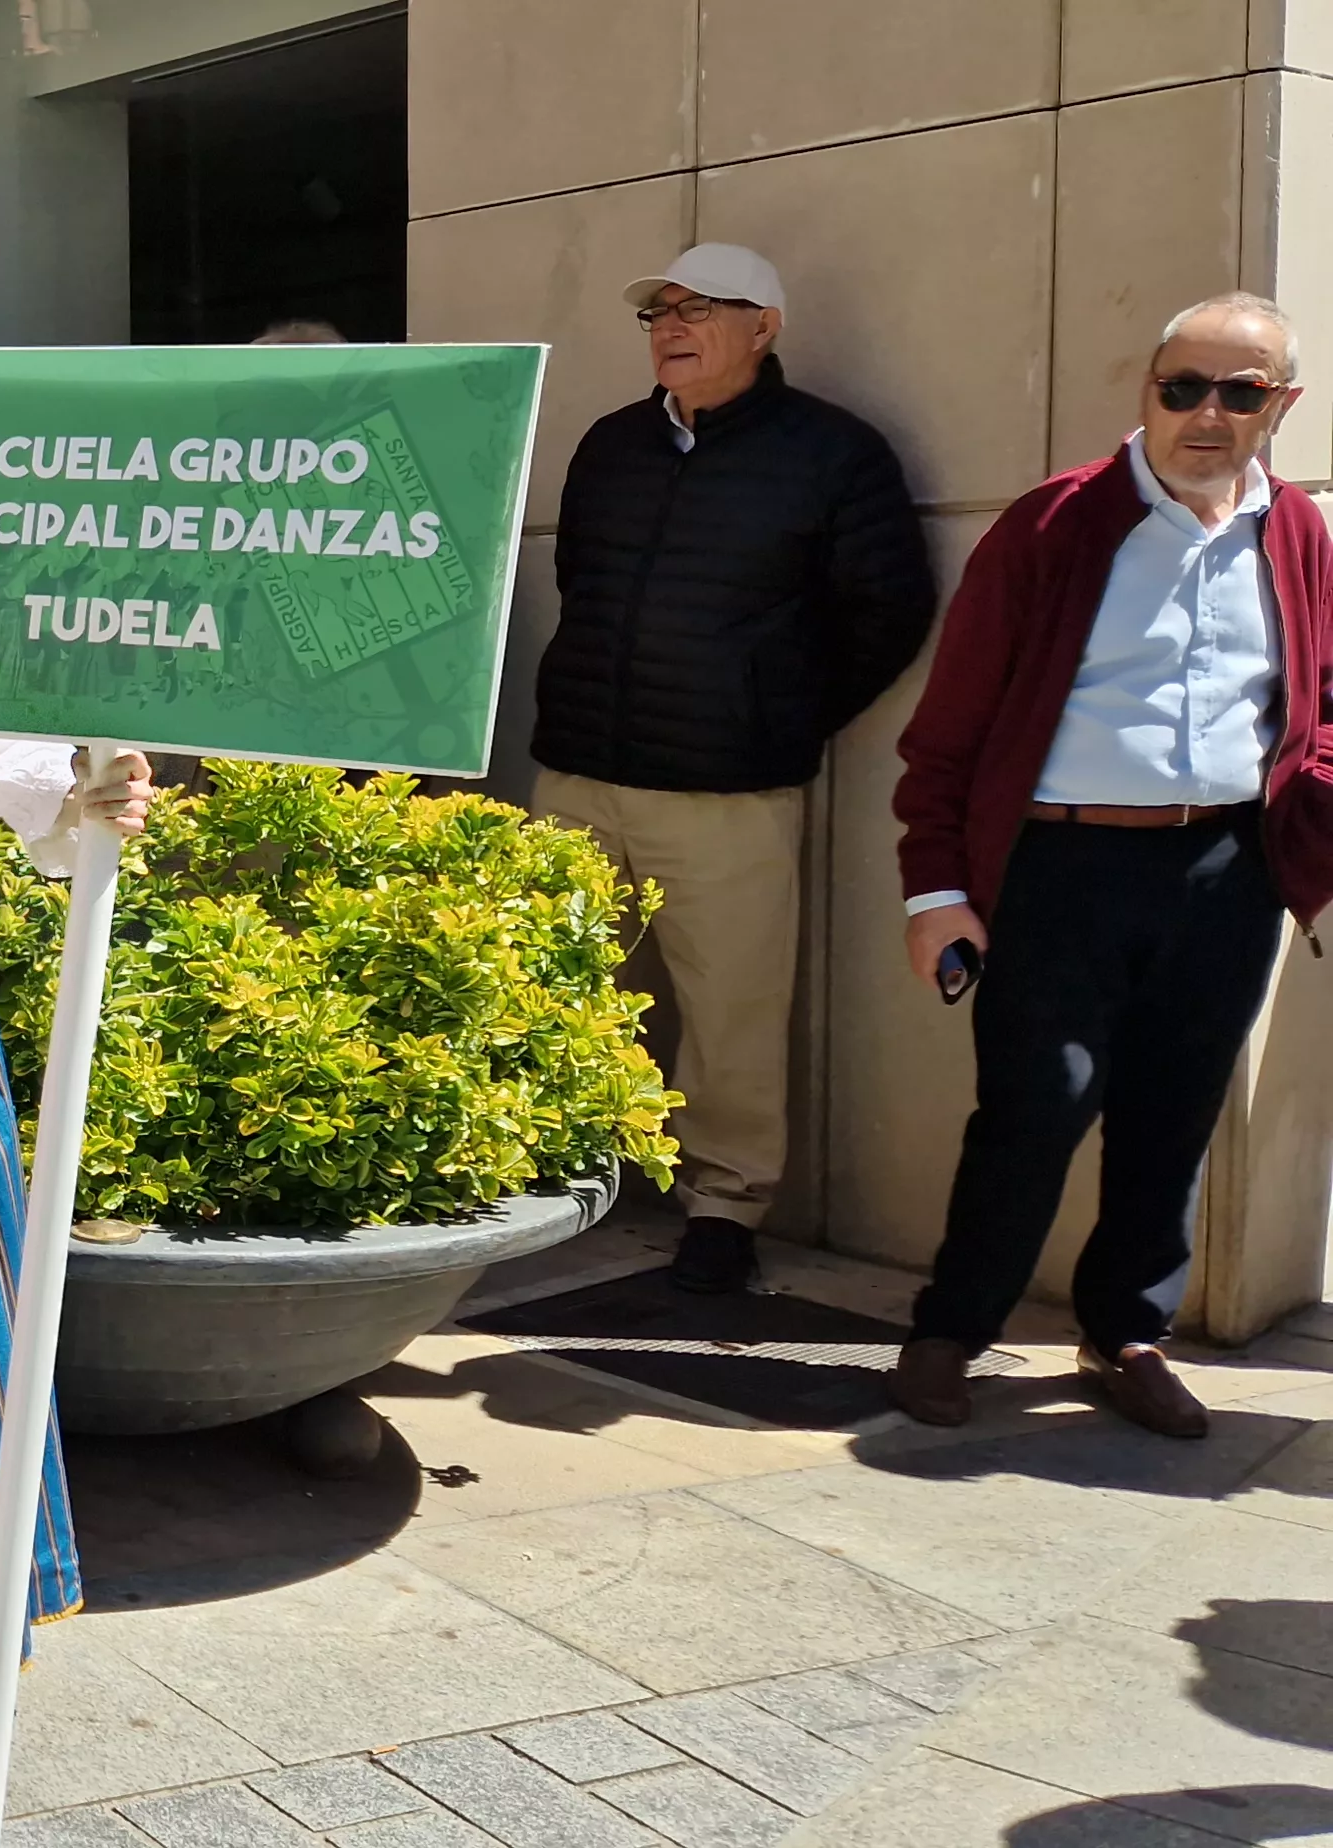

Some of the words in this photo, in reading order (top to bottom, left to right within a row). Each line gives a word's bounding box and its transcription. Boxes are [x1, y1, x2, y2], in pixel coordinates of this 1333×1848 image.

[170, 438, 369, 484] GRUPO
[385, 438, 429, 511] SANTA
[139, 505, 204, 550] DE
[210, 506, 441, 559] DANZAS
[24, 594, 222, 651] TUDELA
[334, 602, 441, 660] HUESCA
